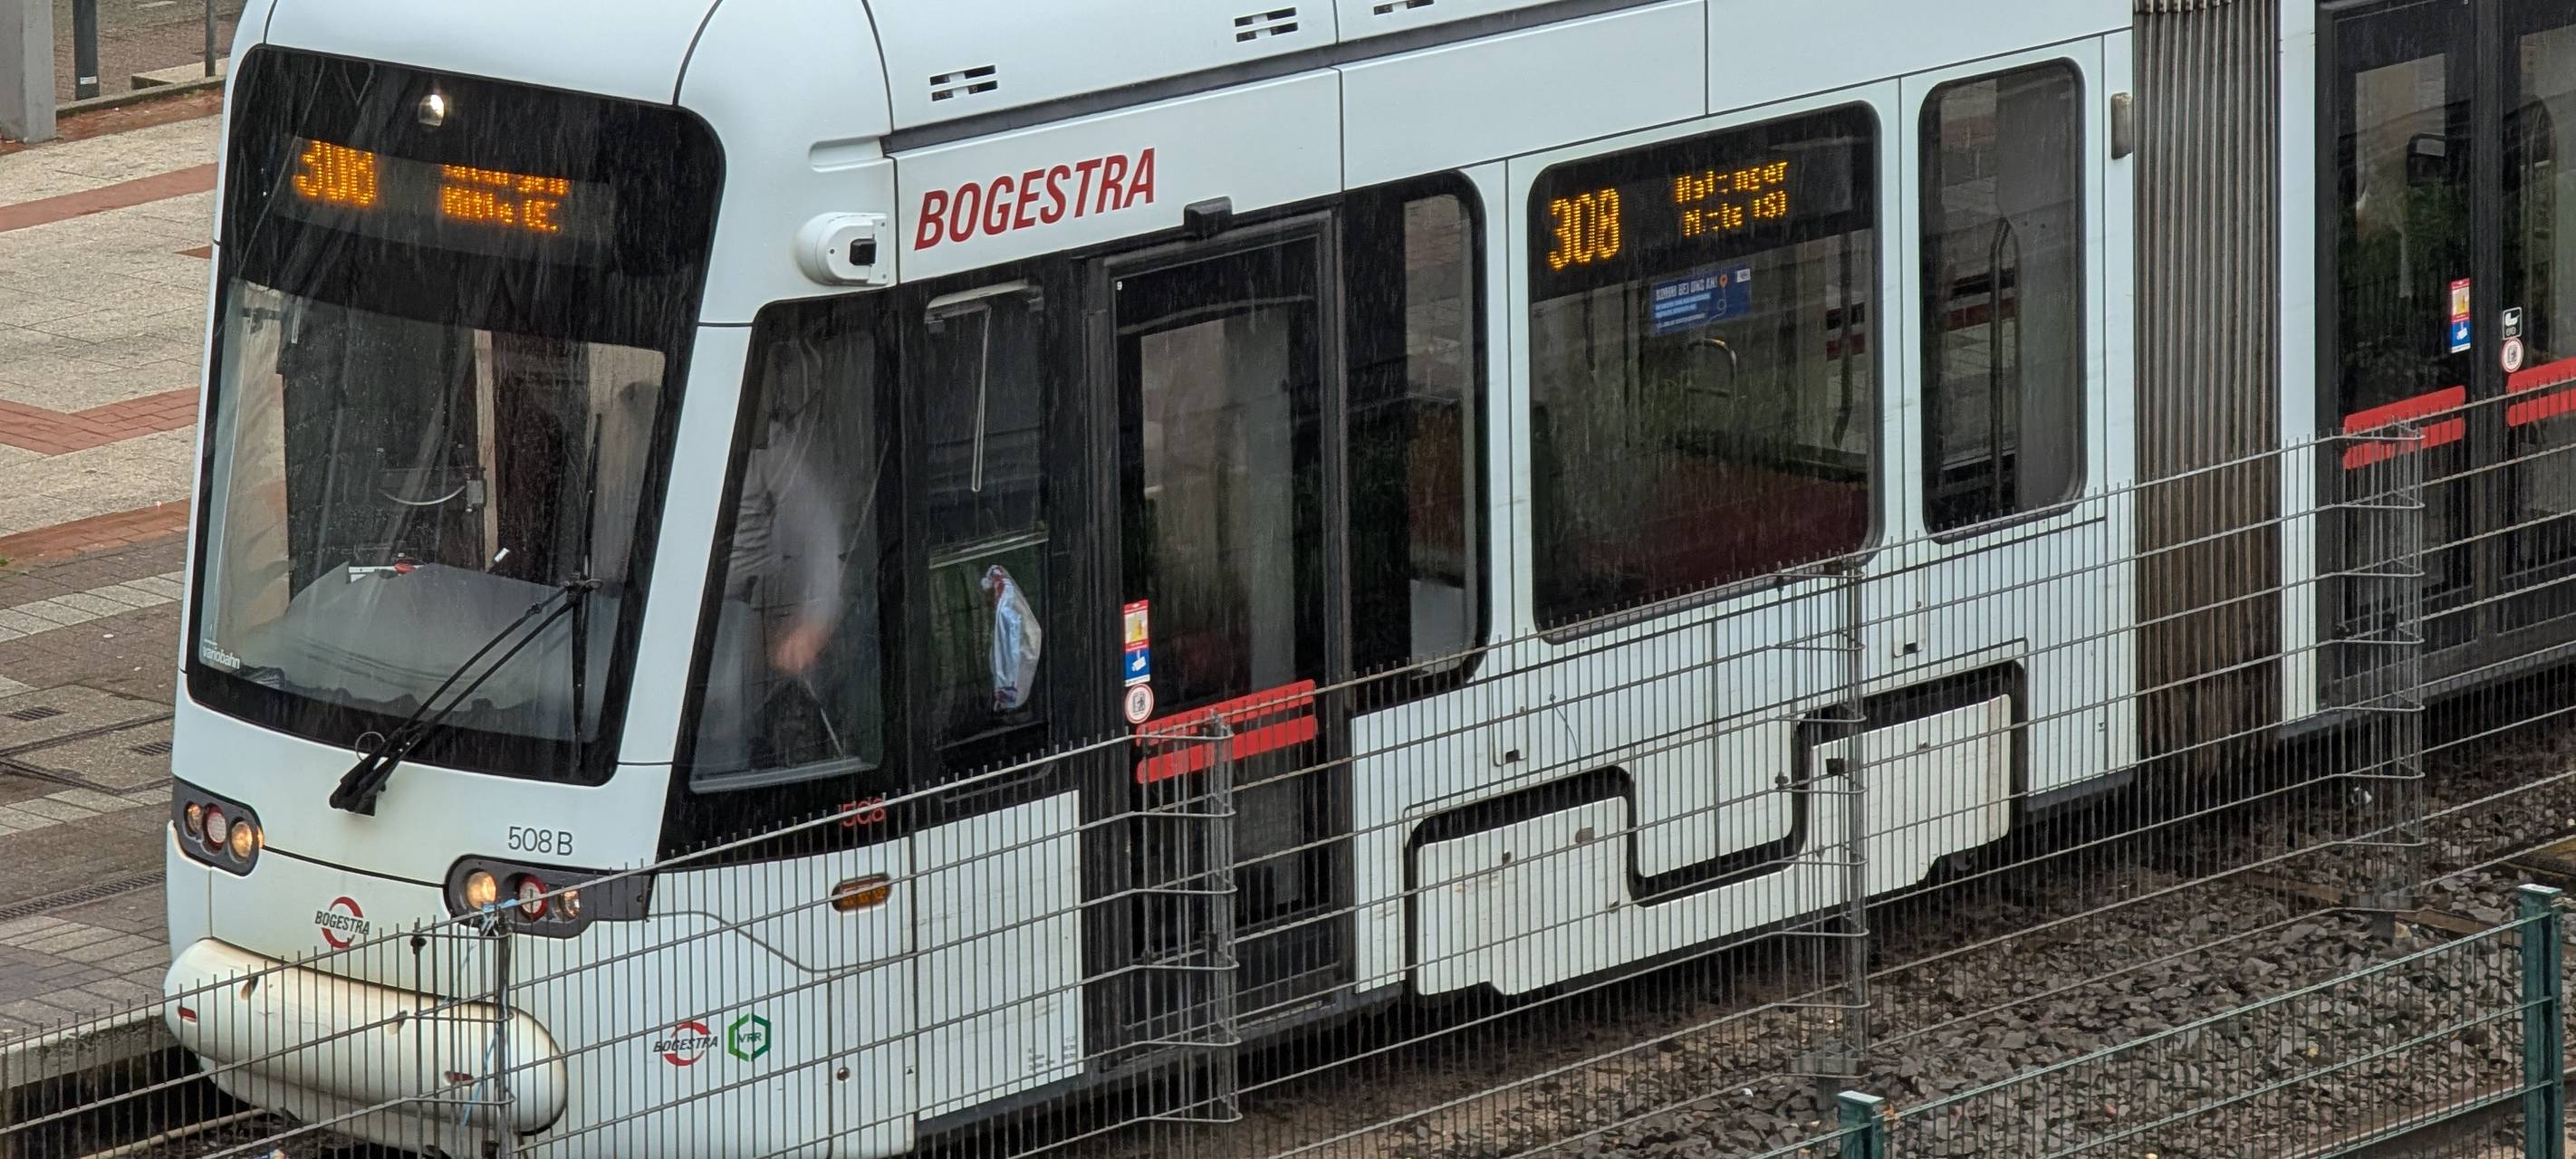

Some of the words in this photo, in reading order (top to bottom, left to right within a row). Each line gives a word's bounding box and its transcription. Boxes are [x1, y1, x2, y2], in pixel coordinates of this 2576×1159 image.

[292, 140, 375, 206] 308
[914, 148, 1155, 251] BOGESTRA
[1546, 187, 1621, 271] 308
[1683, 202, 1743, 237] Mte
[203, 646, 240, 669] variobahn
[841, 797, 886, 828] 508
[314, 910, 370, 936] BOGESTRA
[652, 1035, 719, 1053] BOGESTRA
[737, 1031, 763, 1044] VRR
